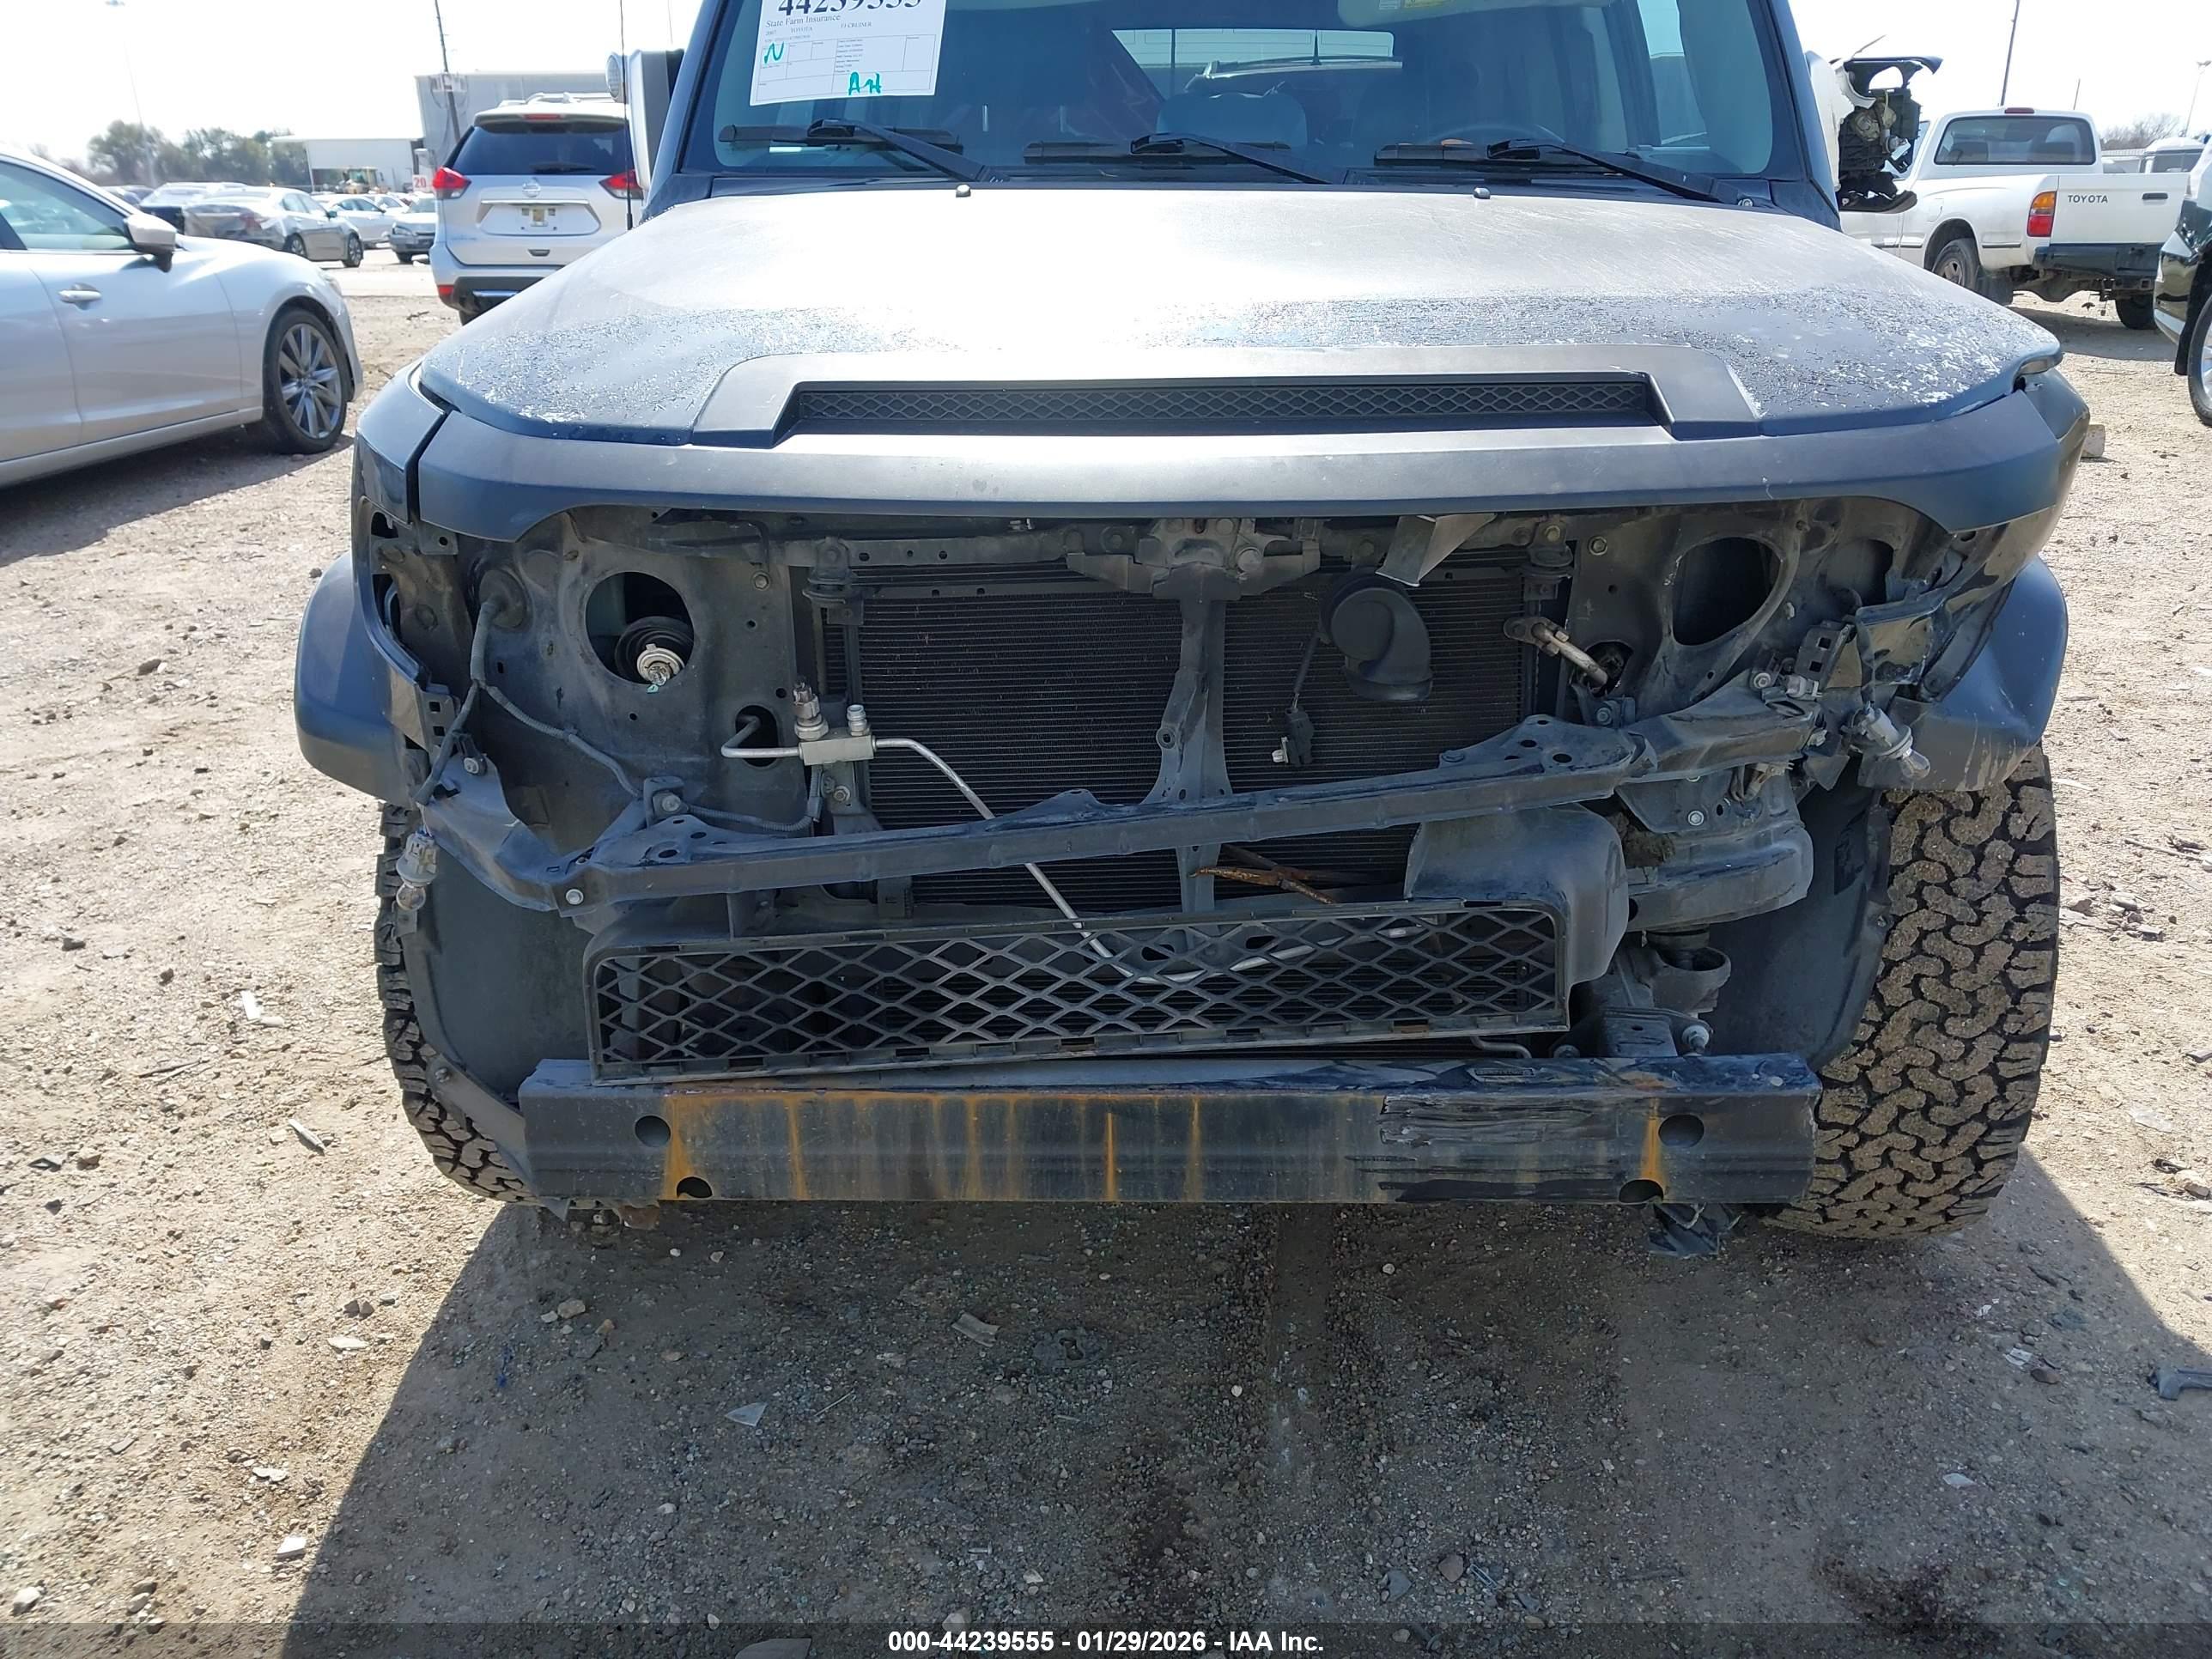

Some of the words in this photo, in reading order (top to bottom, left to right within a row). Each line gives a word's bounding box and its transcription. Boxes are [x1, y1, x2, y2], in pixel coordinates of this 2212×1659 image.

[806, 15, 841, 23] Insurance
[415, 177, 427, 188] 20
[2068, 194, 2109, 204] TOYOTA
